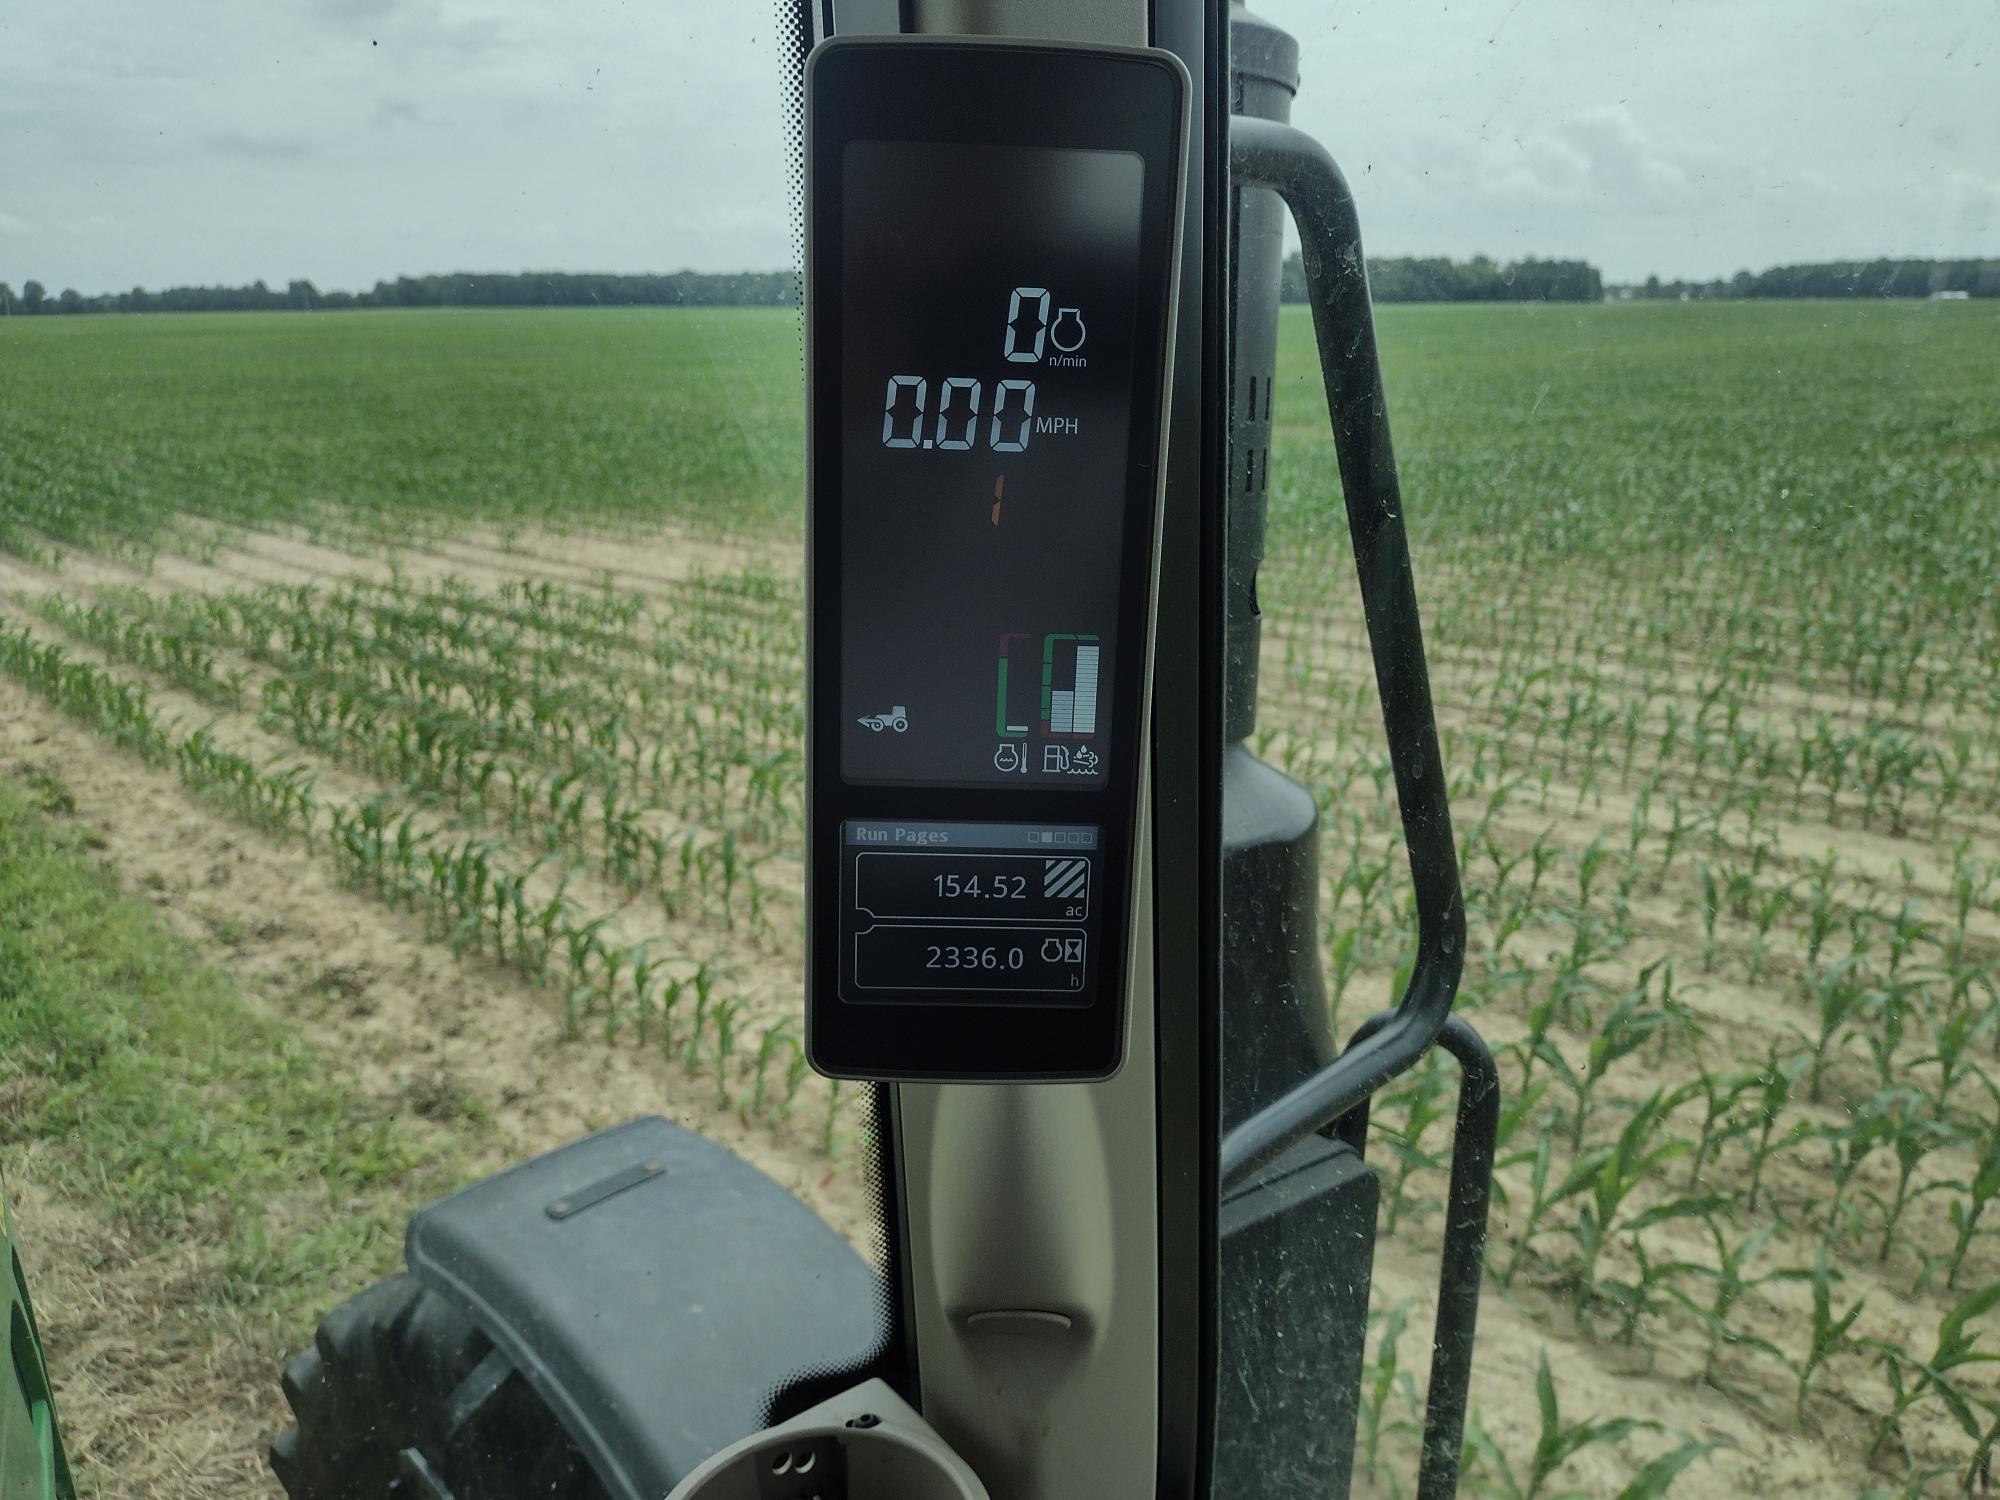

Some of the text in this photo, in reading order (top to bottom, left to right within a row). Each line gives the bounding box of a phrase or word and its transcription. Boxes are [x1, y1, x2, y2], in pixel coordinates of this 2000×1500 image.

[1004, 287, 1051, 363] 0
[1049, 354, 1087, 367] n/min
[882, 374, 1036, 452] 0.00
[1036, 416, 1079, 435] MPH
[856, 827, 948, 845] Run Pages
[933, 875, 1027, 900] 154.52
[1065, 907, 1083, 917] ac
[926, 945, 1025, 970] 2336.0
